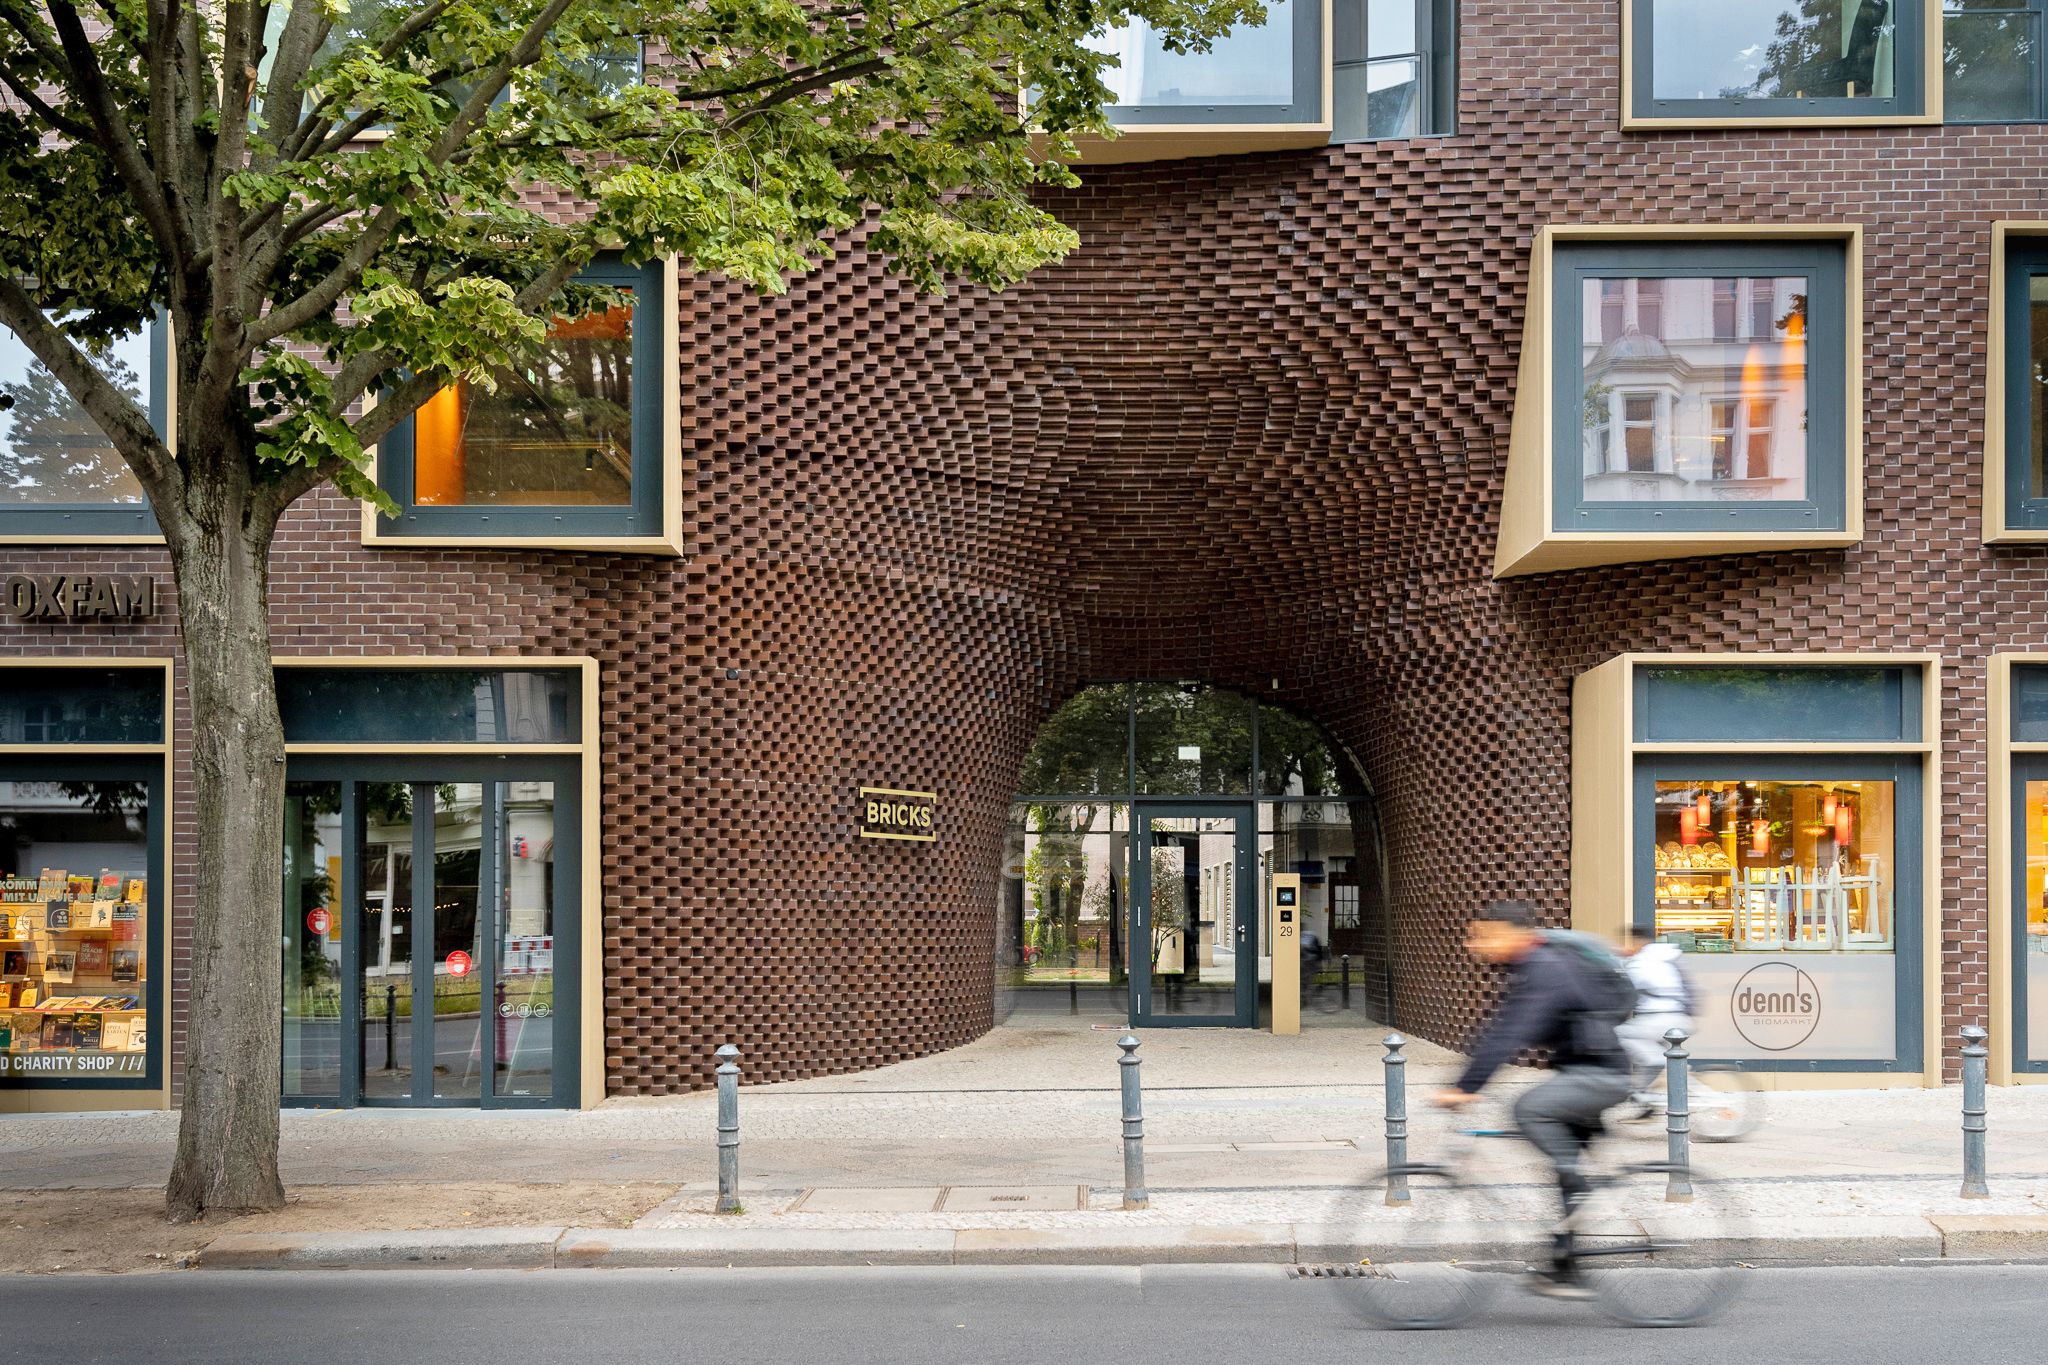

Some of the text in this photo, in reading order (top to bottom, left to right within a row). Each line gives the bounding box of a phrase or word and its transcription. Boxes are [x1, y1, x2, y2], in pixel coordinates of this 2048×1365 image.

[5, 576, 153, 617] OXFAM
[867, 801, 931, 828] BRICKS
[1280, 926, 1293, 937] 29
[1738, 980, 1813, 1013] denn's
[0, 1056, 9, 1070] D
[14, 1056, 73, 1070] CHARITY
[77, 1056, 115, 1070] SHOP
